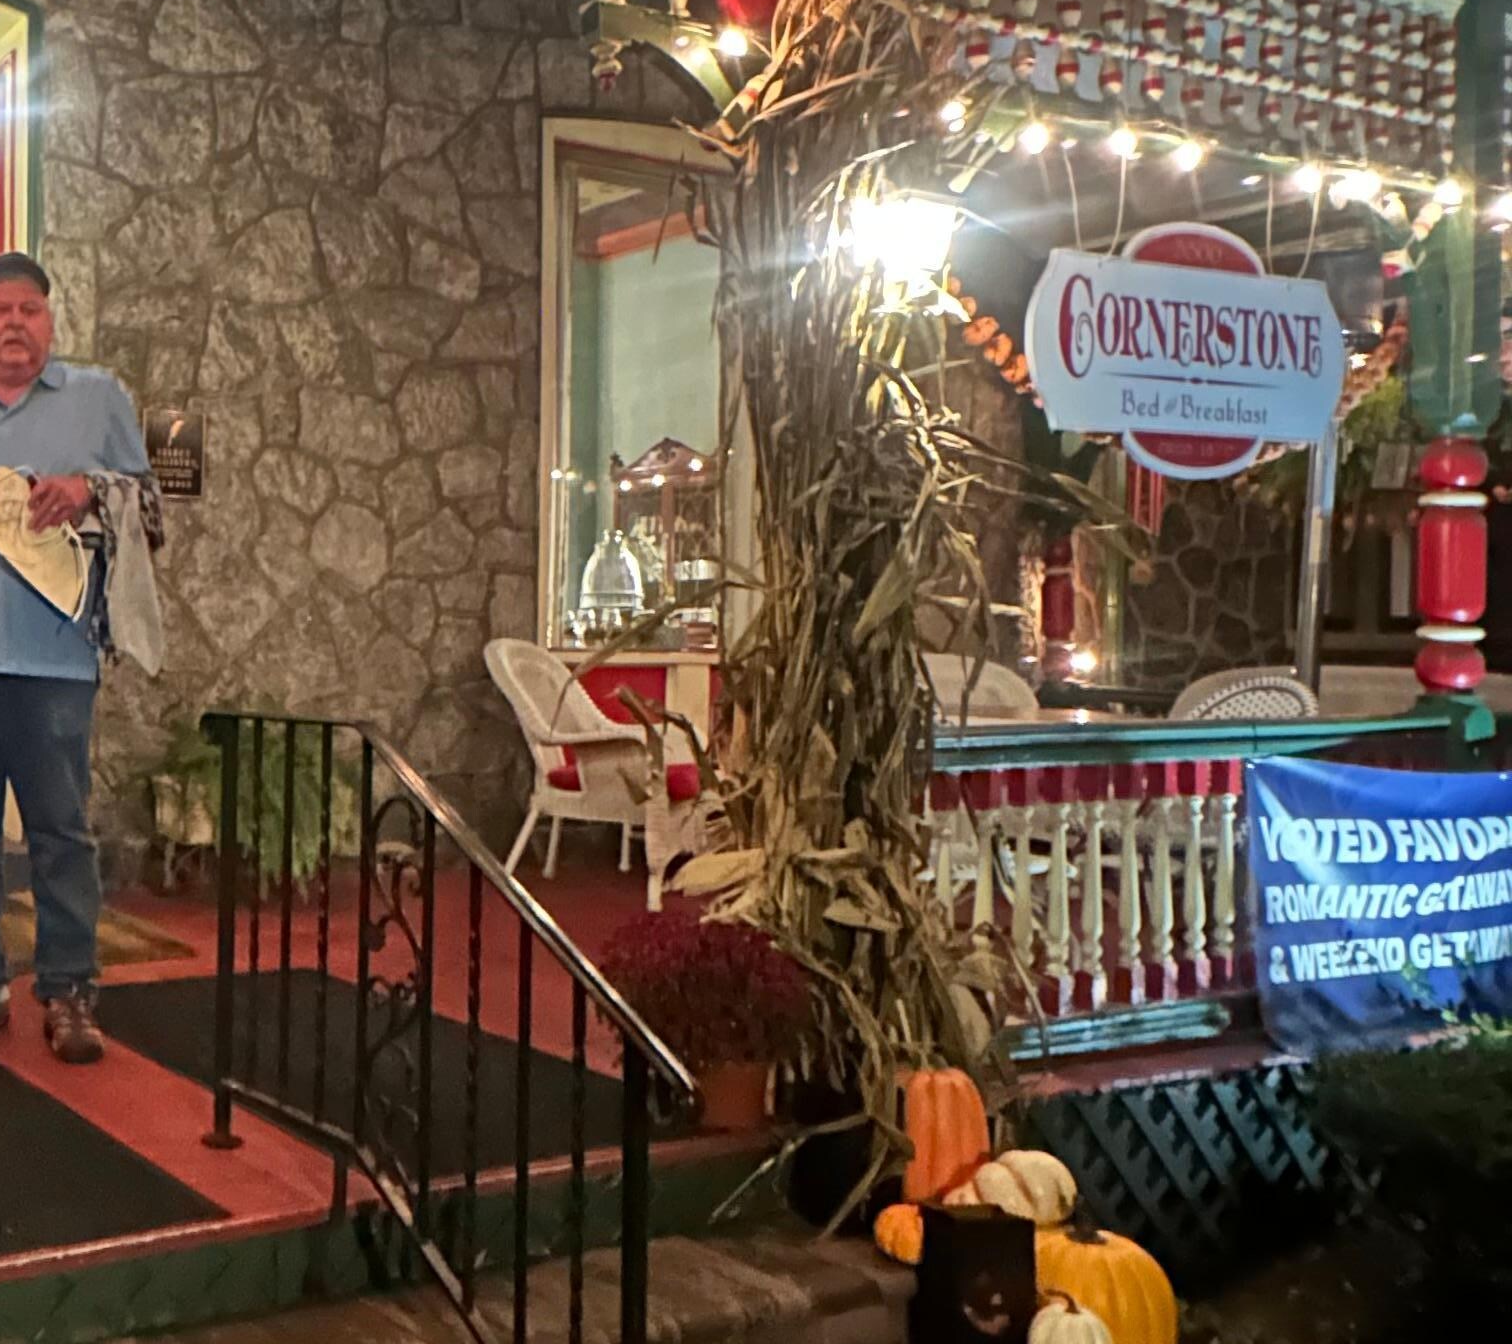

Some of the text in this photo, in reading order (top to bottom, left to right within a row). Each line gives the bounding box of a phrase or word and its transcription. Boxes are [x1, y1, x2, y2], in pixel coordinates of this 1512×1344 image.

[1058, 273, 1323, 379] CORNERSTONE
[1121, 388, 1160, 418] Bed
[1180, 394, 1268, 425] Breakfast
[1259, 815, 1512, 864] VOTED FAVOR
[1264, 883, 1419, 924] ROMANTIC
[1269, 945, 1290, 985] &
[1409, 923, 1512, 970] GETAWA
